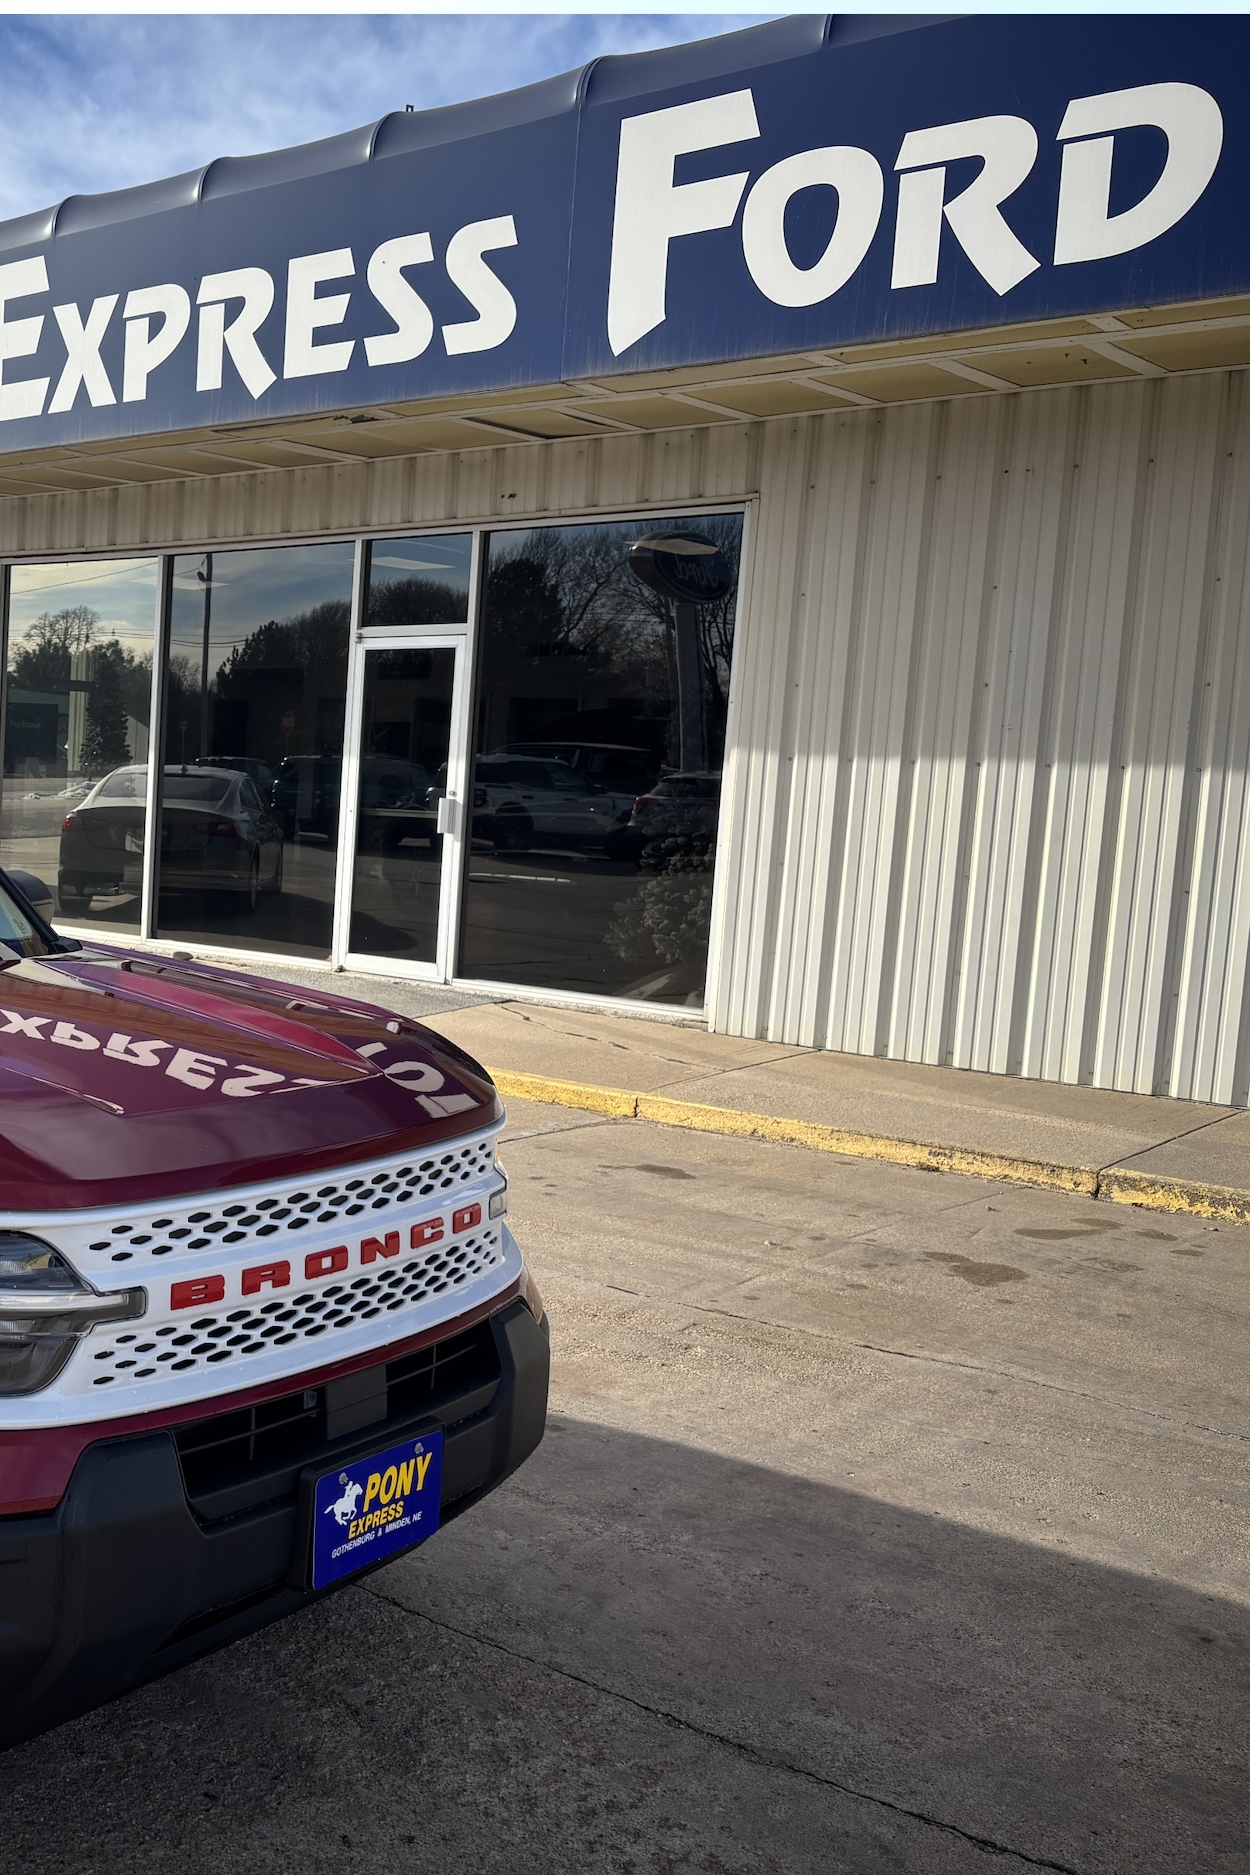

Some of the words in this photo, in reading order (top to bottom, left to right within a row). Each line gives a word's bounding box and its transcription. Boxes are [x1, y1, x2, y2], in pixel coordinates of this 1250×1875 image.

[605, 81, 1225, 358] FORD
[169, 1202, 482, 1311] BRONCO
[362, 1451, 433, 1513] PONY
[331, 1530, 376, 1559] GOTHENBURG
[376, 1527, 383, 1537] &
[385, 1519, 412, 1533] MINDEN,
[412, 1512, 422, 1523] NE
[347, 1500, 405, 1540] EXPRESS
